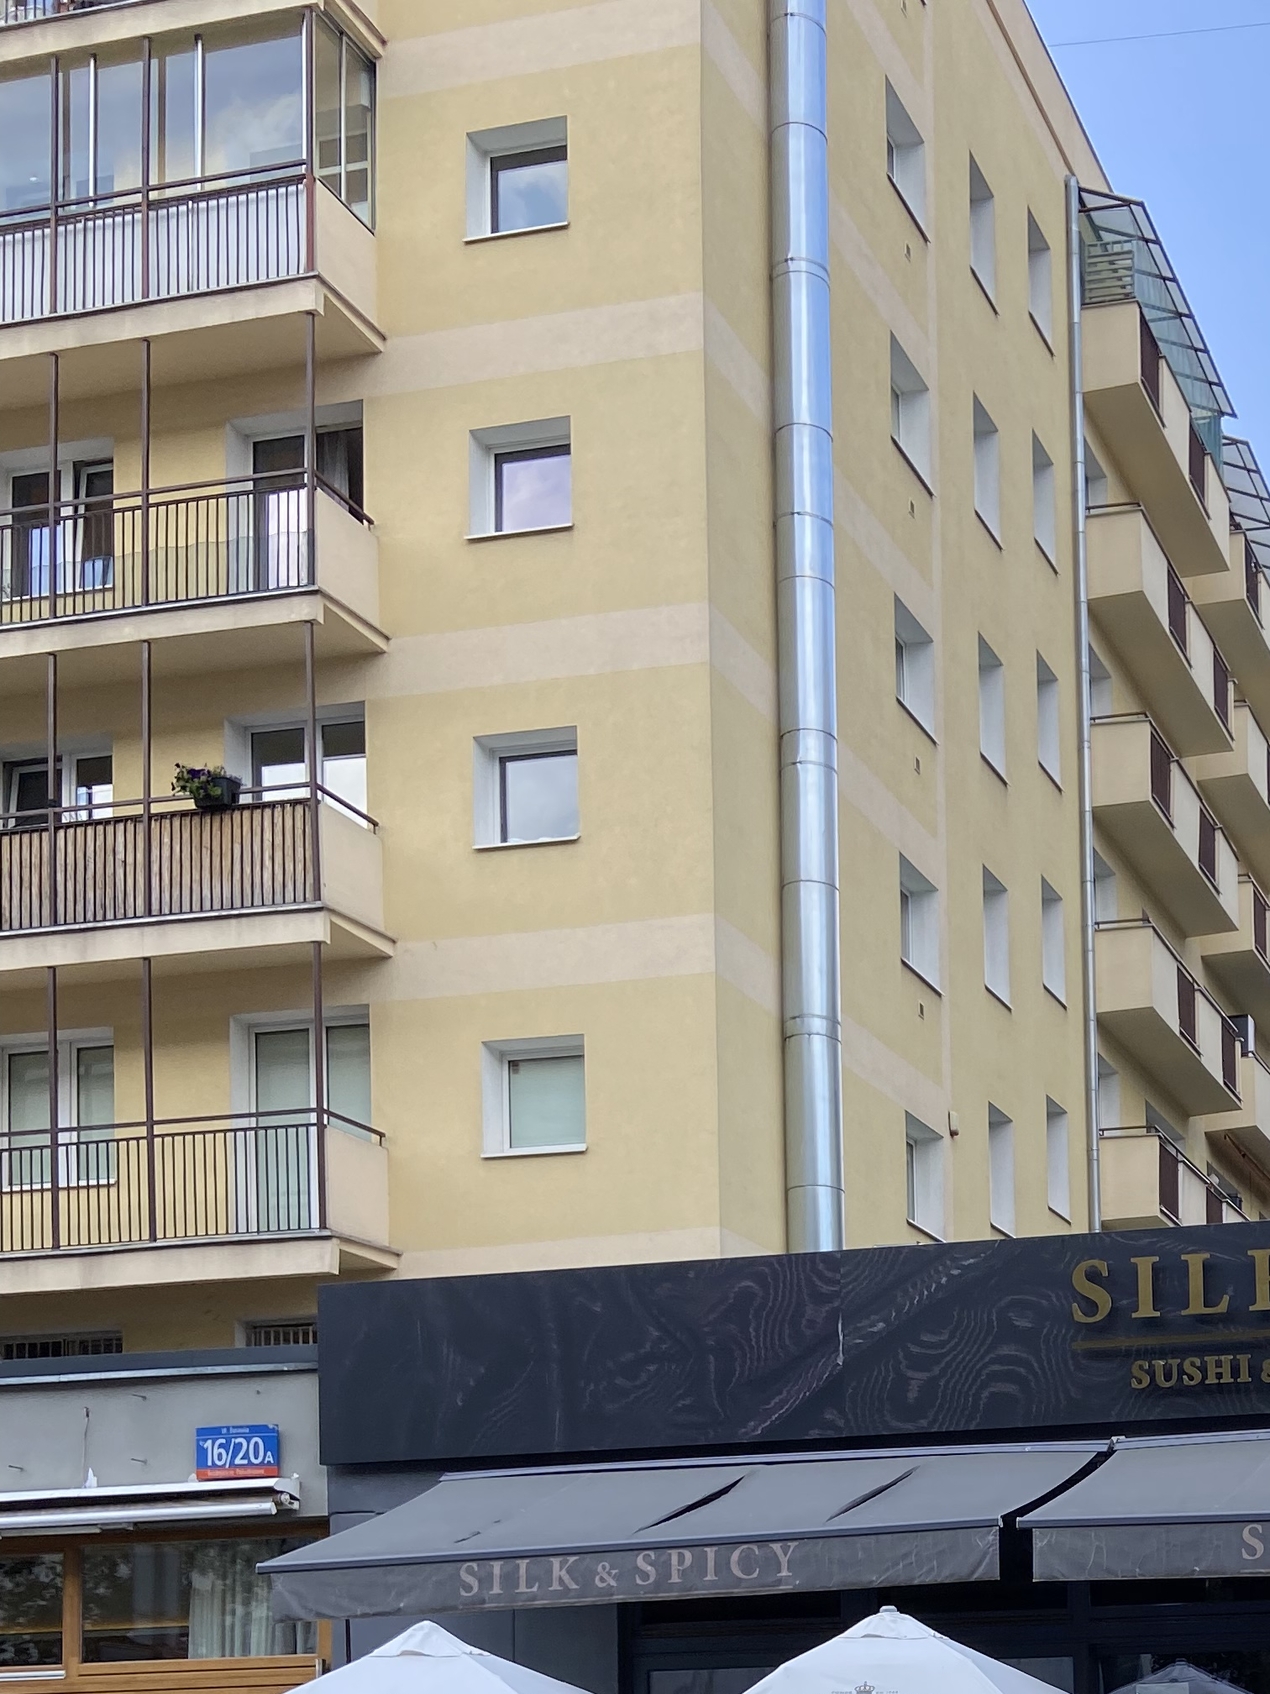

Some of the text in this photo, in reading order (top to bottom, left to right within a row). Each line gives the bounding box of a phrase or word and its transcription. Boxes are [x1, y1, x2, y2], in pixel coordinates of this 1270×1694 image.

[1130, 1354, 1252, 1389] SUSHI
[459, 1541, 799, 1596] SILK & SPICY
